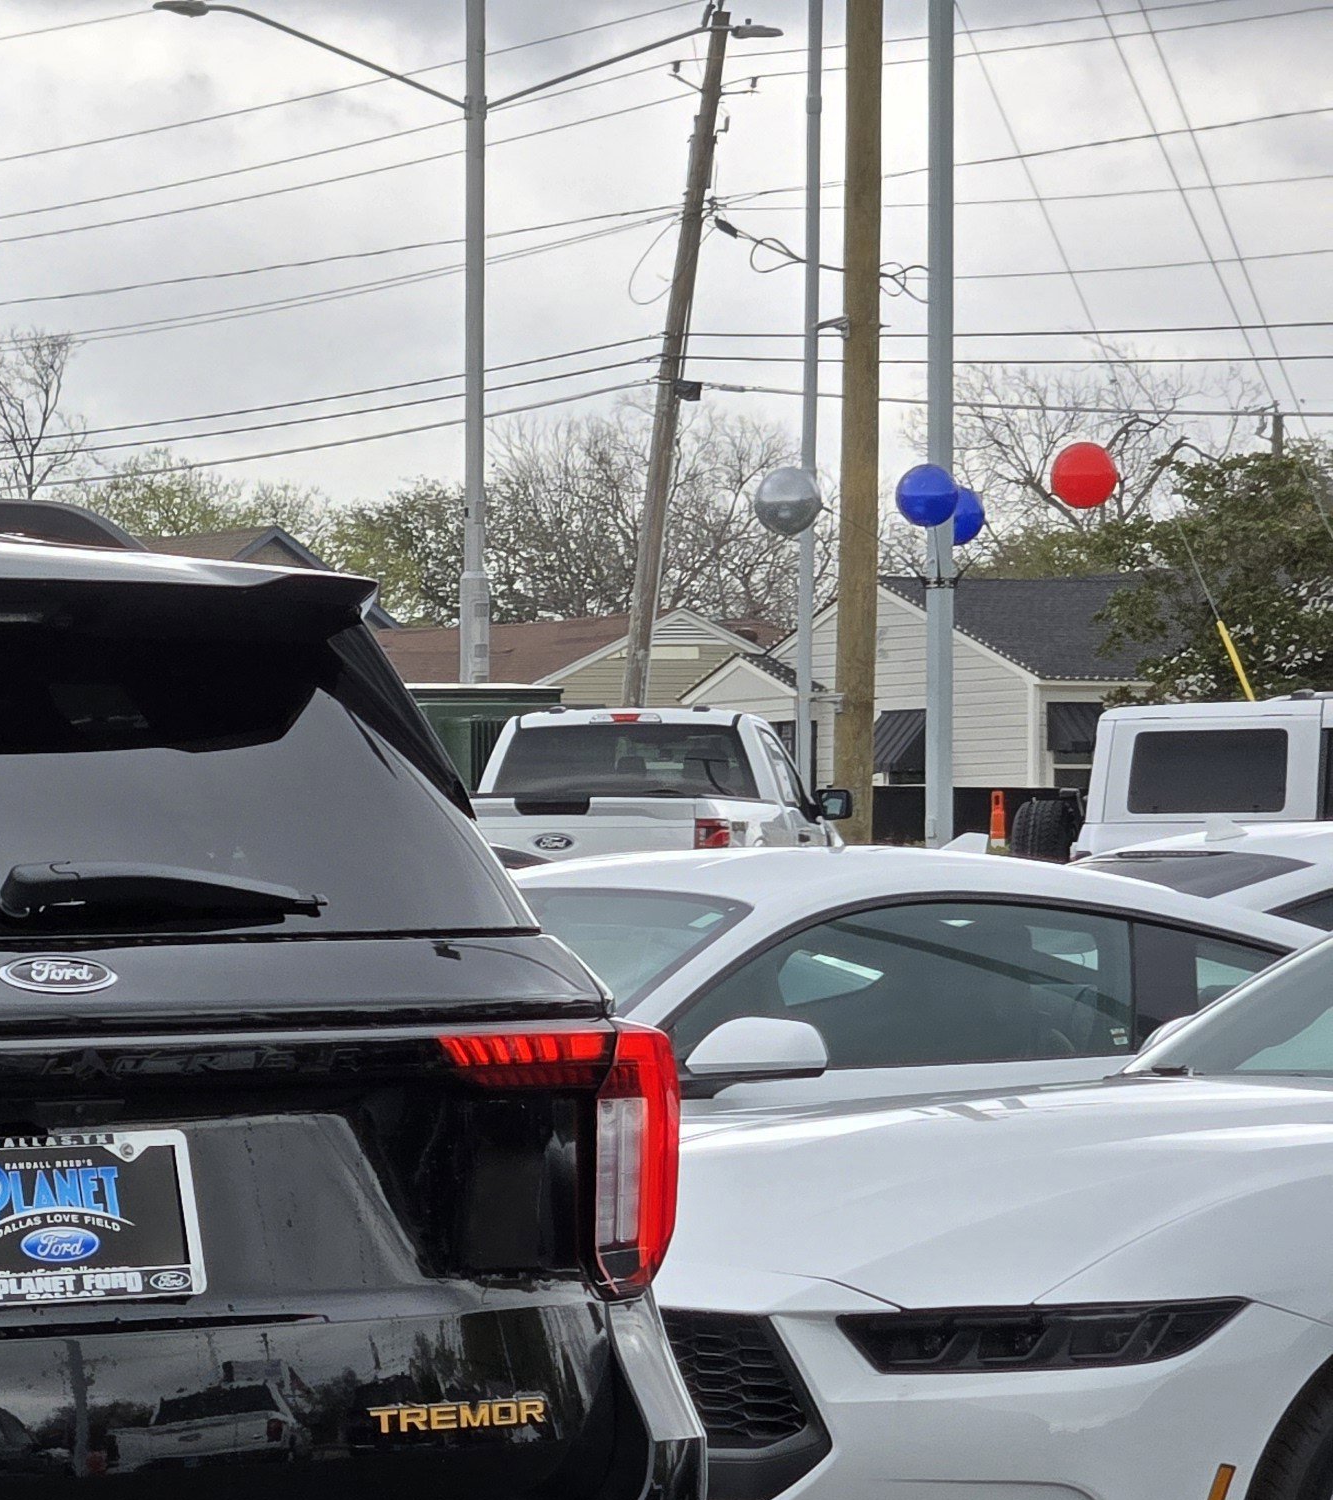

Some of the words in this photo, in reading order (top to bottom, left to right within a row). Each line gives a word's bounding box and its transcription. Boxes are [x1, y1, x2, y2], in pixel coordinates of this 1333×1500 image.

[30, 960, 94, 982] Ford
[4, 1160, 51, 1171] RANDALL
[46, 1213, 80, 1224] LOVE
[84, 1215, 121, 1232] FIELD
[37, 1233, 85, 1257] Ford
[82, 1271, 143, 1293] FORD
[369, 1400, 546, 1434] TREMOR
